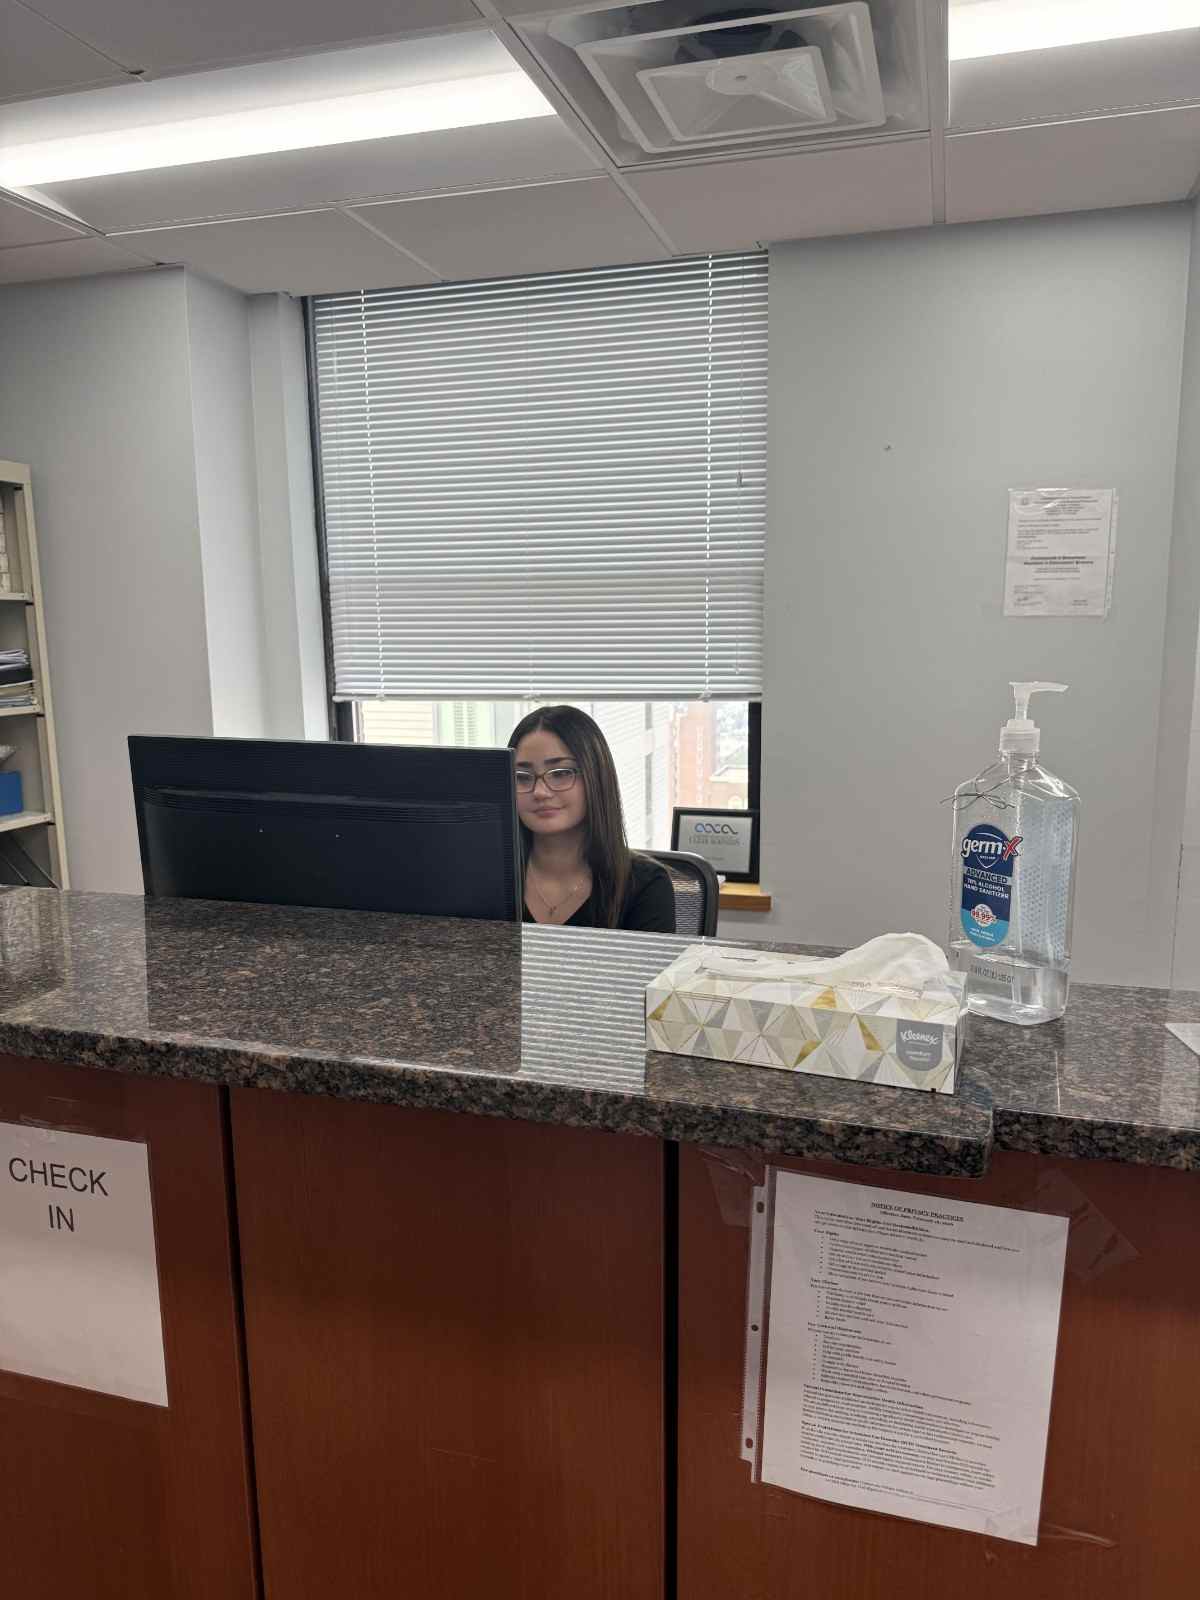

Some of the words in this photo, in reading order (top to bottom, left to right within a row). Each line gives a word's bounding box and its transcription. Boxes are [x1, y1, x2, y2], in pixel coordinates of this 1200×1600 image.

[965, 867, 1008, 884] ADVANCED
[964, 883, 978, 892] HAND
[979, 887, 1009, 899] SANITIZER
[979, 881, 1004, 892] ALCOHOL
[900, 1029, 939, 1045] Kleenex
[9, 1157, 108, 1197] CHECK
[48, 1204, 75, 1232] IN
